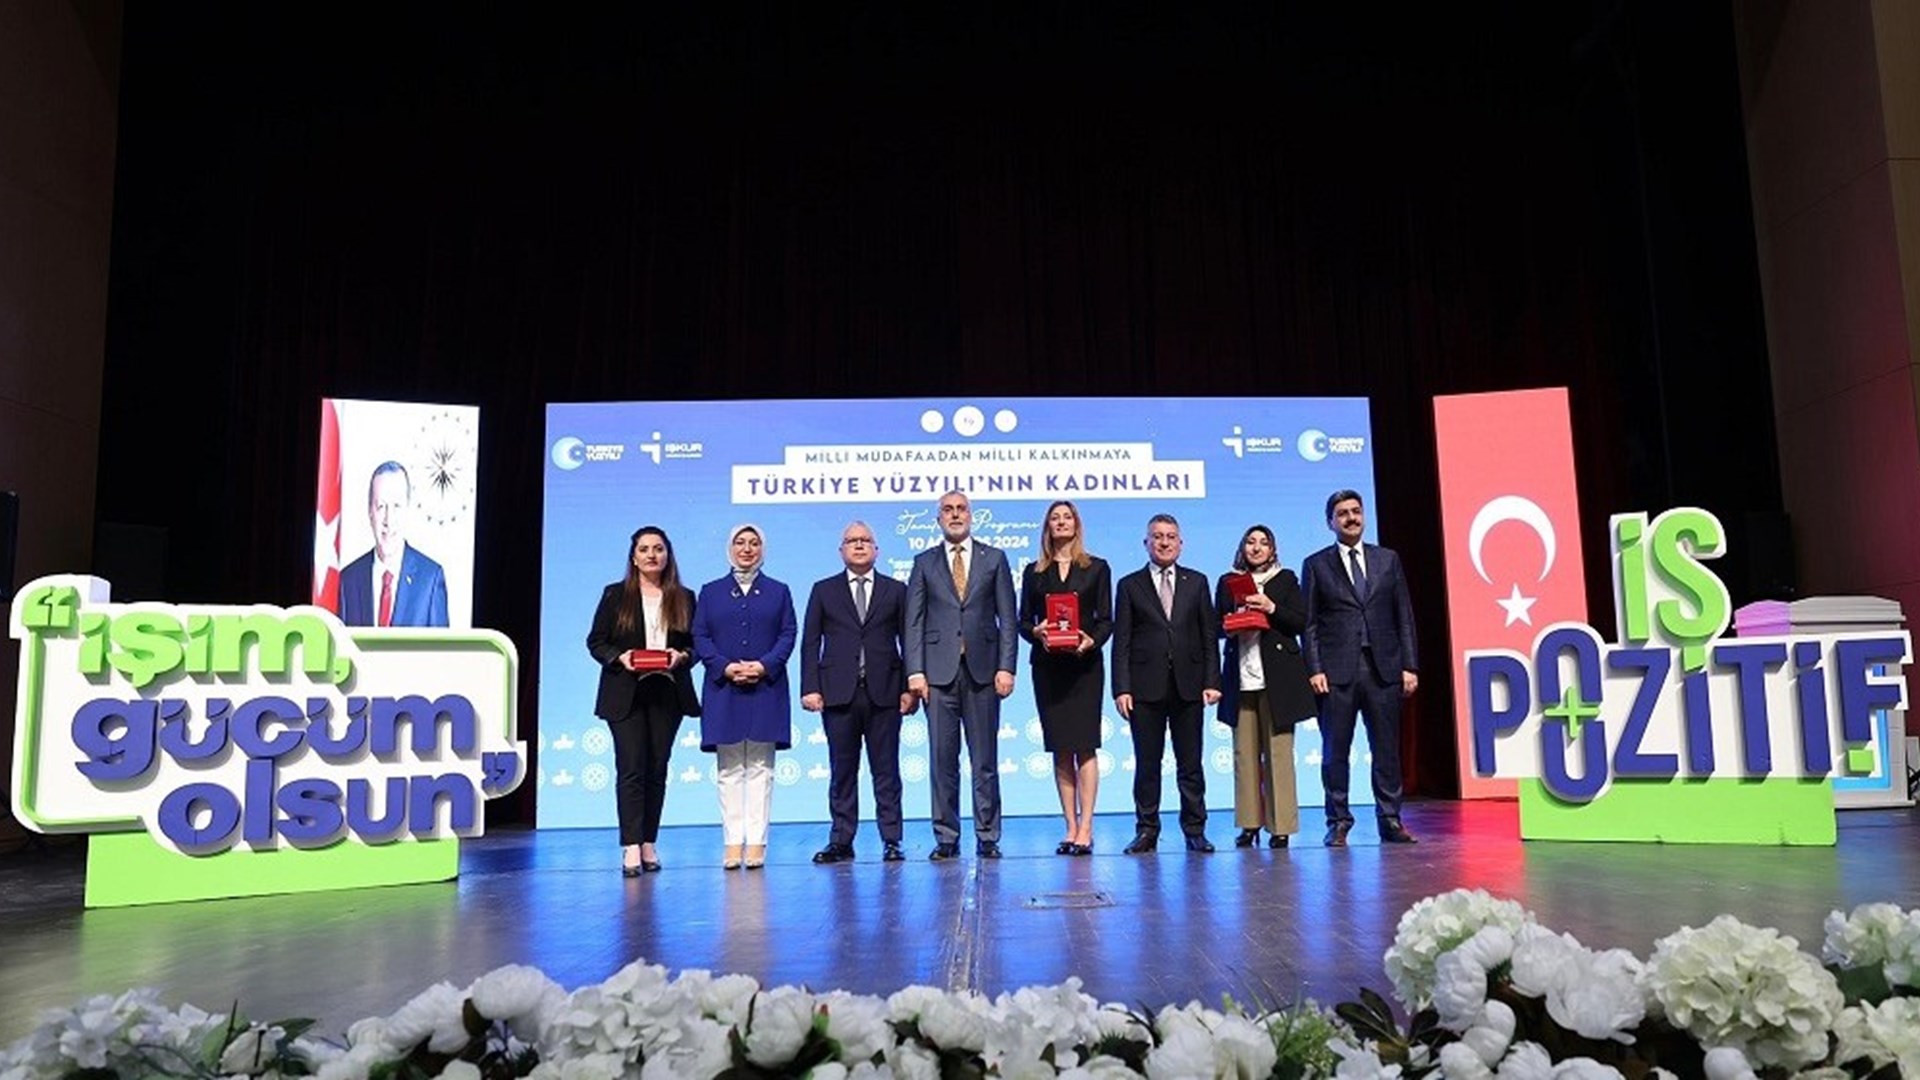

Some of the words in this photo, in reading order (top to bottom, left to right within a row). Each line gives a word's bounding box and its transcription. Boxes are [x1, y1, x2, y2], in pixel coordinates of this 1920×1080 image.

[1029, 448, 1132, 461] KALKINMAYA
[747, 473, 860, 496] TÜRKİYE
[1046, 473, 1190, 492] KADINLARI
[908, 536, 925, 550] 10
[992, 535, 1030, 550] 2024
